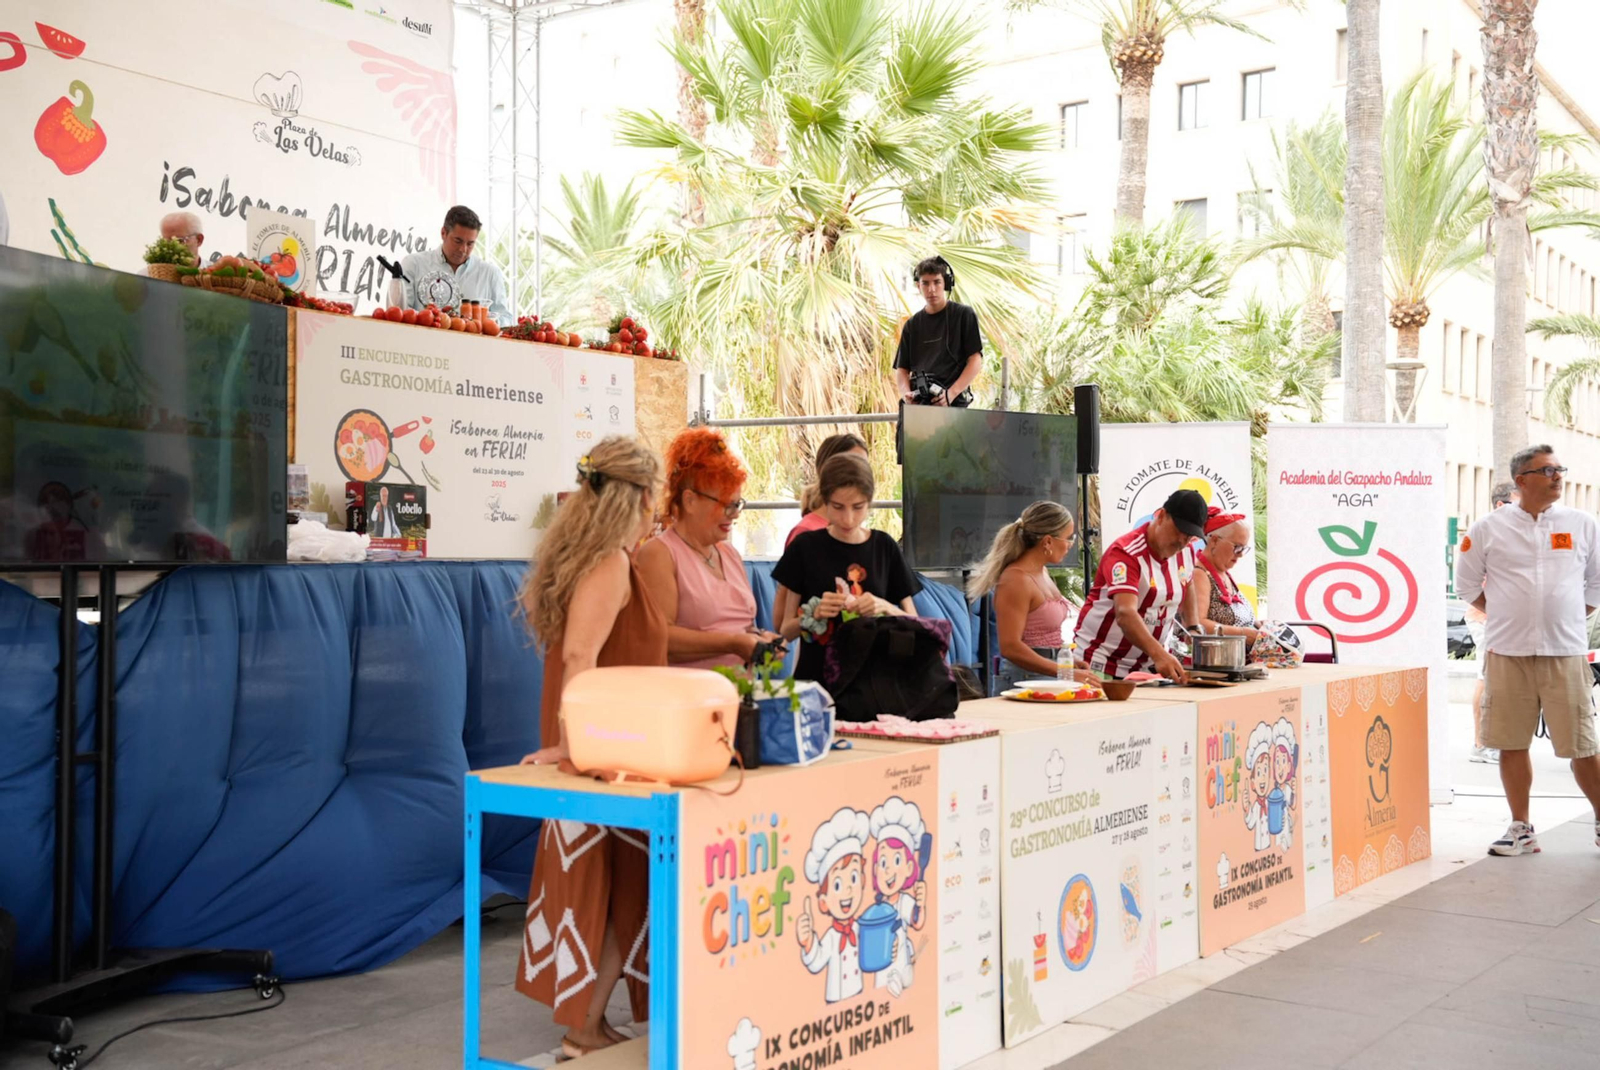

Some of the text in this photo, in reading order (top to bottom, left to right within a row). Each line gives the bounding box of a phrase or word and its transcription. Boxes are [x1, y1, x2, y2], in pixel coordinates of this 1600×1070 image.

[282, 118, 318, 136] Plaza de
[274, 126, 350, 164] Las Velas
[256, 224, 280, 240] TOMATE
[281, 224, 290, 232] DE
[315, 245, 387, 303] RIA!
[340, 345, 450, 370] III ENCUENTRO DE
[340, 368, 544, 404] GASTRONOMÍA almeriense
[450, 419, 500, 437] ¡Saborea
[576, 430, 592, 439] eco
[464, 440, 527, 460] en FERIA!
[492, 480, 506, 488] 2025
[1116, 459, 1239, 511] EL TOMATE DE ALMERÍA
[1280, 469, 1432, 489] Academia del Gazpacho Andaluz
[1332, 493, 1378, 507] "AGA"
[1206, 721, 1236, 766] mini
[1028, 791, 1088, 824] CONCURSO
[1089, 788, 1100, 808] de
[1010, 804, 1148, 858] GASTRONOMÍA ALMERIENSE
[1130, 826, 1148, 840] agosto
[704, 812, 778, 888] mini
[1231, 866, 1238, 882] IX
[1240, 853, 1276, 878] CONCURSO
[1213, 866, 1294, 910] GASTRONOMÍA INFANTIL
[765, 1000, 890, 1060] IX CONCURSO DE
[850, 1014, 914, 1056] INFANTIL
